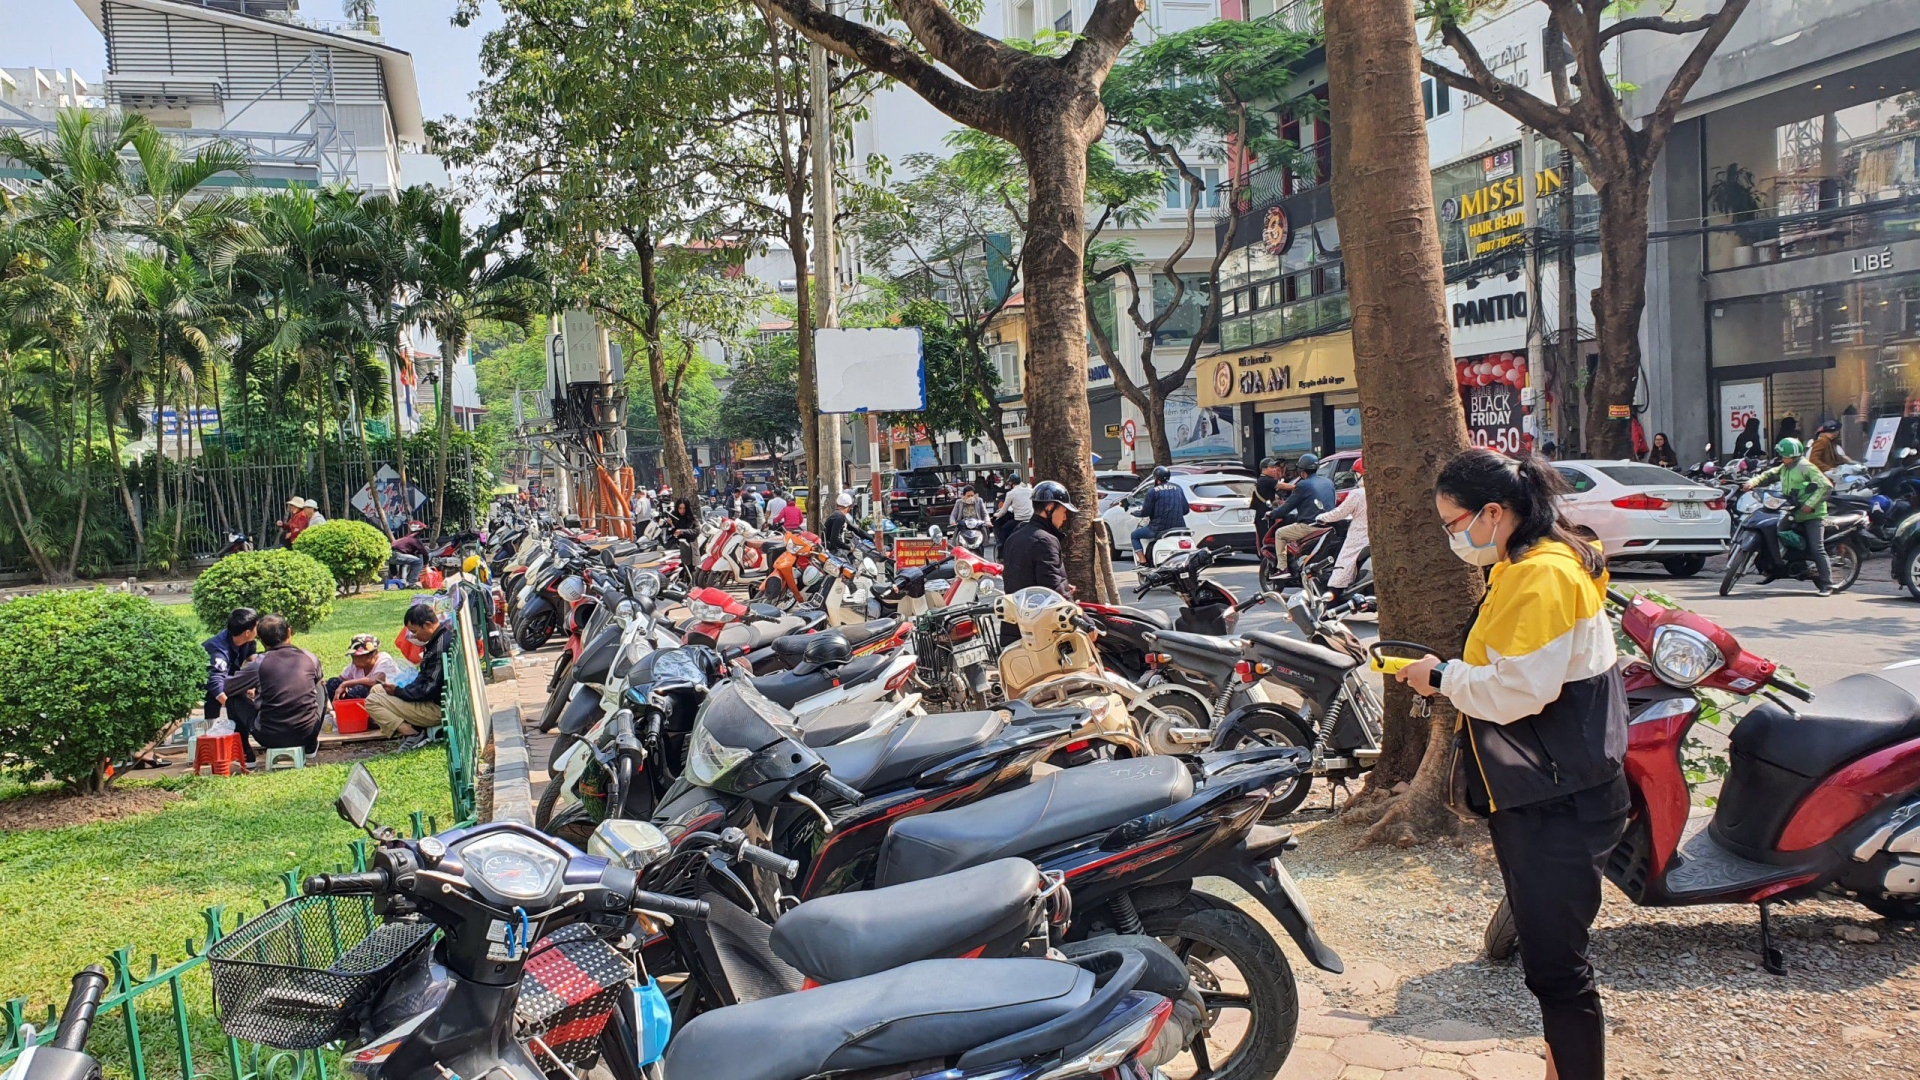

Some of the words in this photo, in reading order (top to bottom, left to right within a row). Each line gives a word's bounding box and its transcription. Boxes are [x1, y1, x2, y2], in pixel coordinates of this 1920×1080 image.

[1469, 219, 1494, 238] HAIR
[1495, 212, 1525, 231] BEAUT
[1852, 246, 1893, 273] LIBÉ
[1452, 291, 1527, 328] PANTIO
[1470, 394, 1511, 412] BLACK
[1470, 411, 1511, 426] FRIDAY
